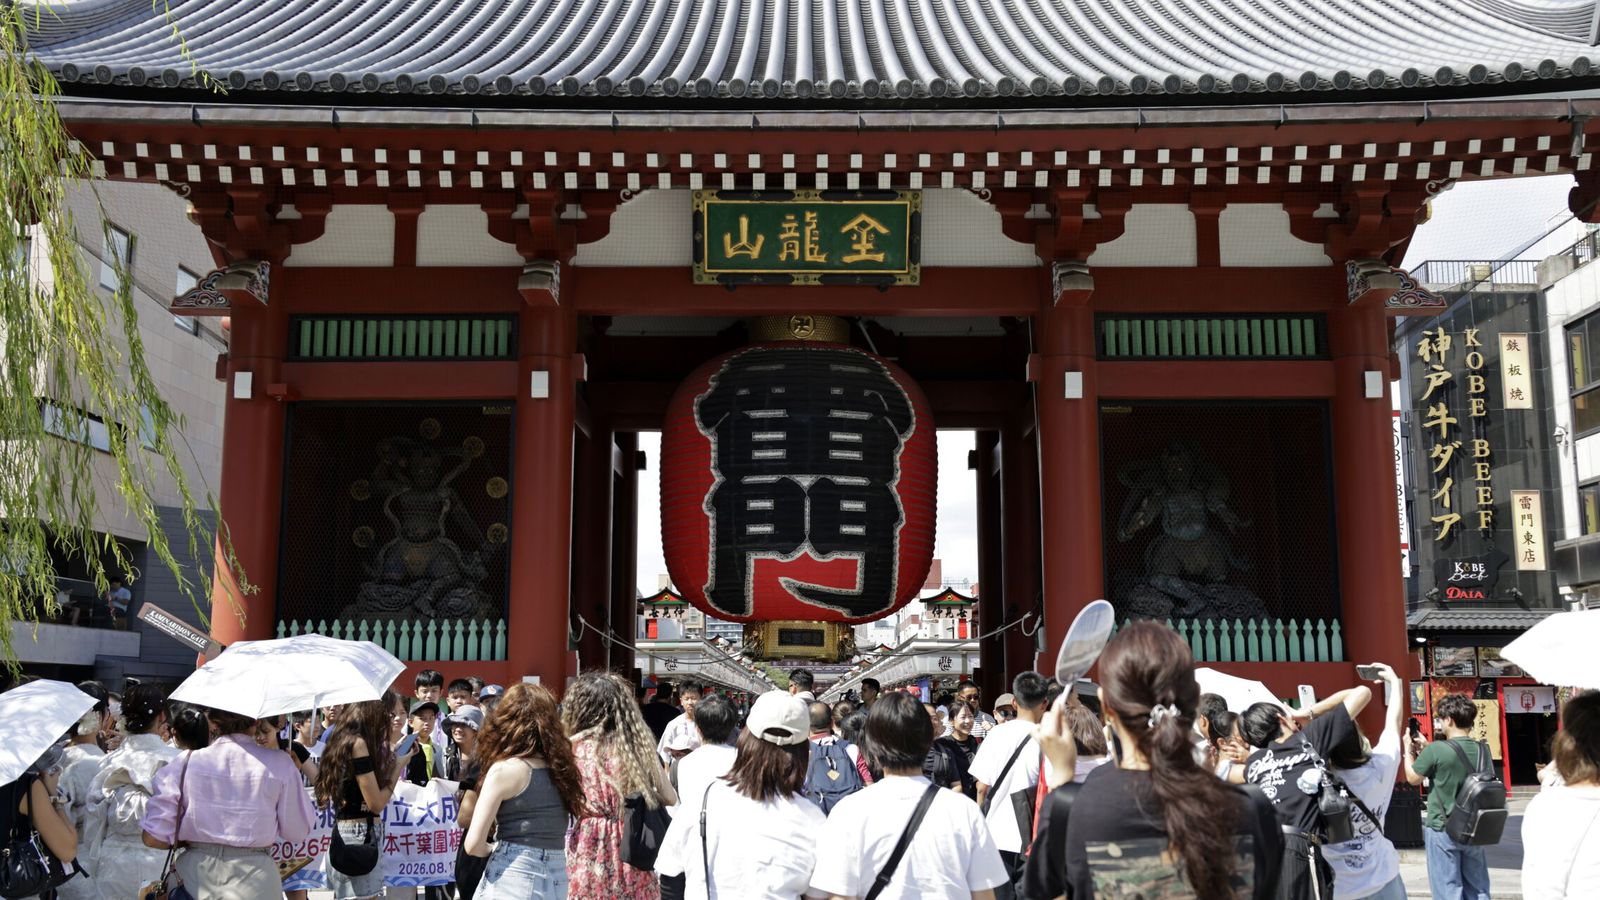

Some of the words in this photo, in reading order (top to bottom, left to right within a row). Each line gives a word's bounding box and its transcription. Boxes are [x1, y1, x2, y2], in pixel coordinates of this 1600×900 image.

[1465, 328, 1487, 417] KOBE
[1506, 339, 1525, 401] 鉄板焼
[1417, 326, 1462, 541] 神戸牛ダイア
[693, 347, 916, 617] 雷門
[1472, 439, 1494, 529] BEEF
[1518, 496, 1537, 563] 雷門東店
[1447, 571, 1489, 581] Beef
[1454, 562, 1485, 573] KOBE
[149, 610, 192, 637] KAMINARIMON
[190, 633, 208, 646] GATE
[382, 794, 459, 826] 立大成
[399, 861, 455, 875] 2026.08.1
